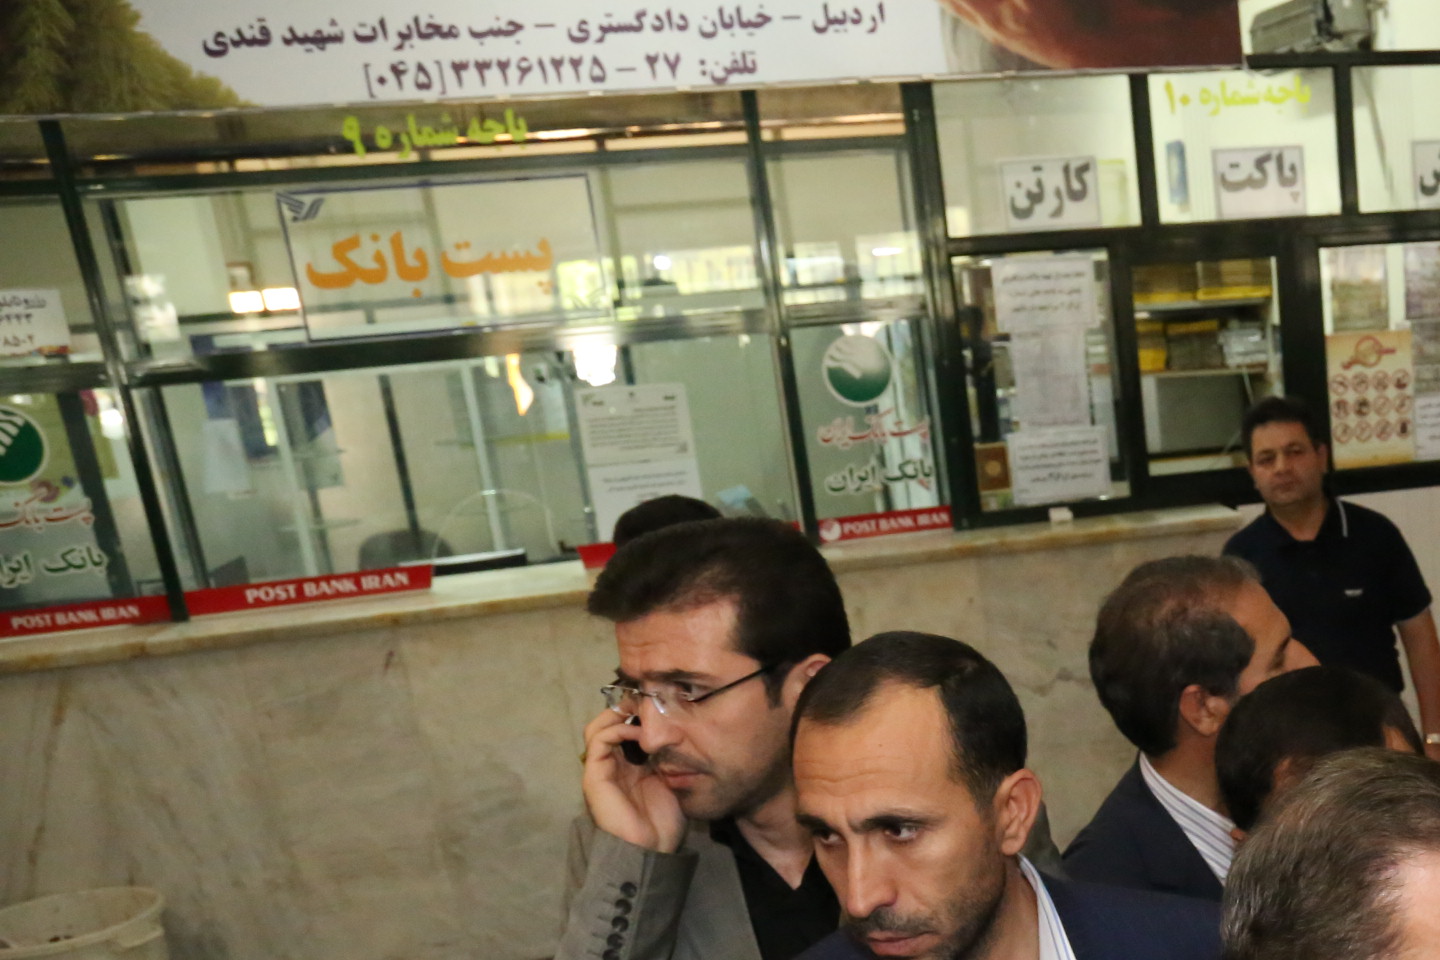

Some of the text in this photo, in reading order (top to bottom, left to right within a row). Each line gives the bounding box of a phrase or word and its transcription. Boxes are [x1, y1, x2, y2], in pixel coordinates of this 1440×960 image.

[281, 18, 344, 52] شهید
[353, 14, 460, 50] مخابرات
[467, 16, 525, 41] جنب
[567, 9, 689, 43] دادگستری
[699, 6, 773, 39] خیابان
[812, 2, 885, 34] اردبیل
[202, 18, 272, 58] قندی
[645, 53, 682, 80] ۲۷
[699, 50, 757, 84] تلفن:
[1200, 79, 1261, 117] شماره
[1263, 73, 1312, 115] باجه
[342, 108, 528, 160] باجه شماره ۹
[1009, 160, 1091, 220] کارتن
[1219, 151, 1301, 203] پاکت
[304, 230, 556, 299] پست بانک
[827, 458, 933, 492] بانک ایران
[843, 511, 950, 535] POST BANK IRAN
[44, 548, 104, 573] بانک
[244, 571, 410, 604] POST BANK IRAN
[11, 604, 141, 630] POST BANK IRAN
